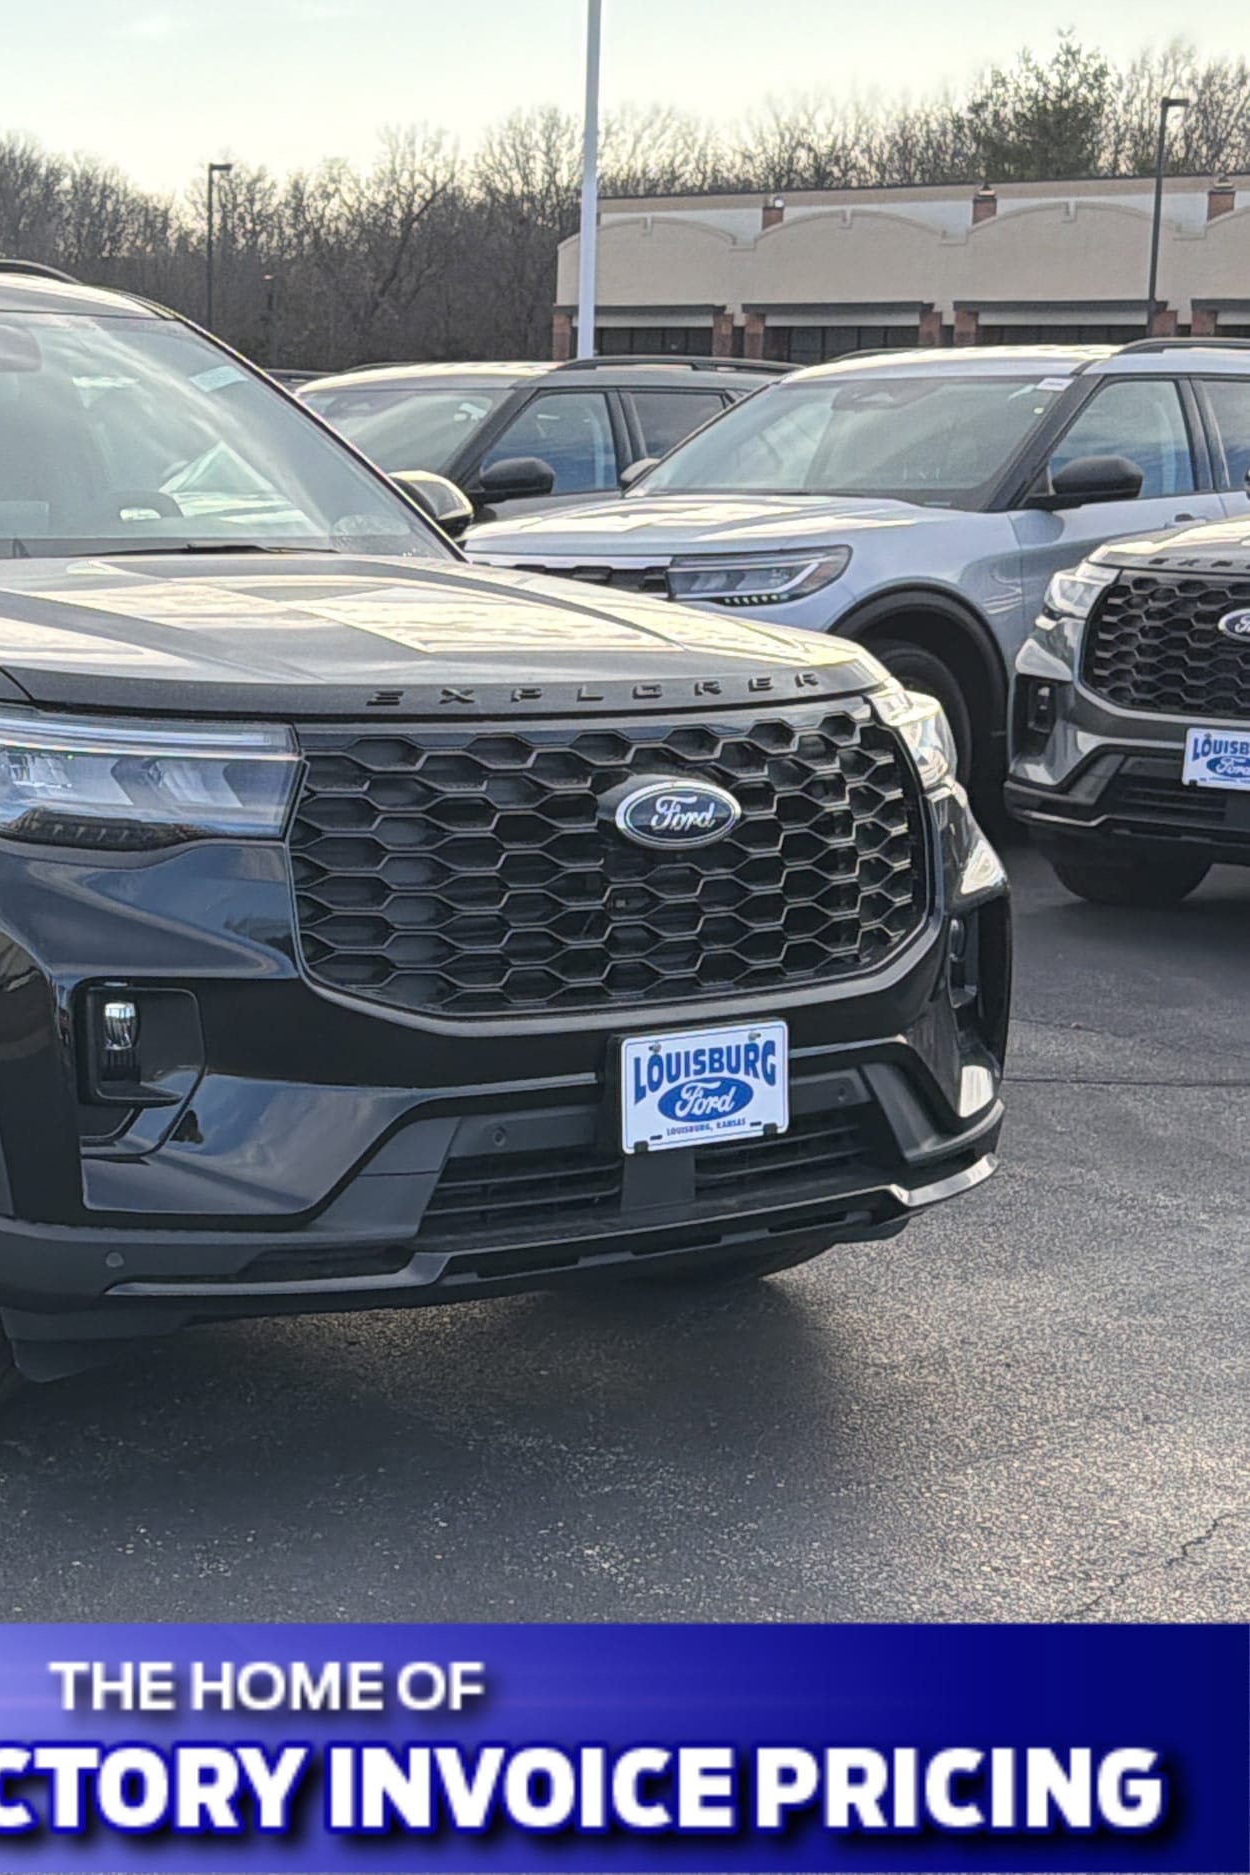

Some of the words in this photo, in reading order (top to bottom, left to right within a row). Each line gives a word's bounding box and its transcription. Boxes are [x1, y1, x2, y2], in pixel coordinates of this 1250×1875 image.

[365, 672, 820, 707] EXPLORER
[650, 795, 717, 832] Ford
[633, 1040, 777, 1106] LOUISBURG
[675, 1081, 735, 1118] Ford
